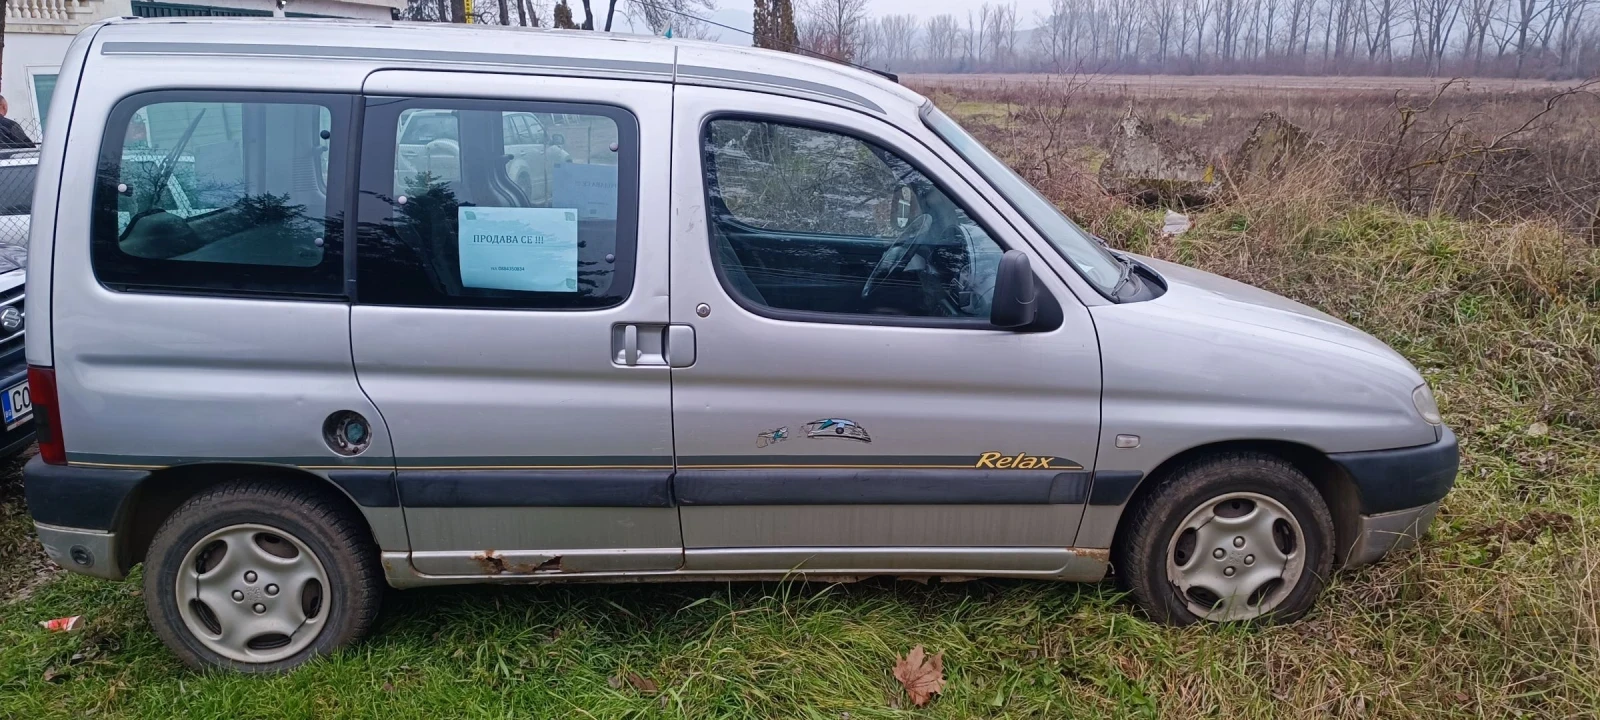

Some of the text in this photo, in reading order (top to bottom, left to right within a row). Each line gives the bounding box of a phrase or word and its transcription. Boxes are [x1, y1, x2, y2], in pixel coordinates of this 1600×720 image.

[473, 234, 518, 244] ПРОДАВА
[521, 235, 533, 244] СЕ
[976, 451, 1055, 469] Relax
